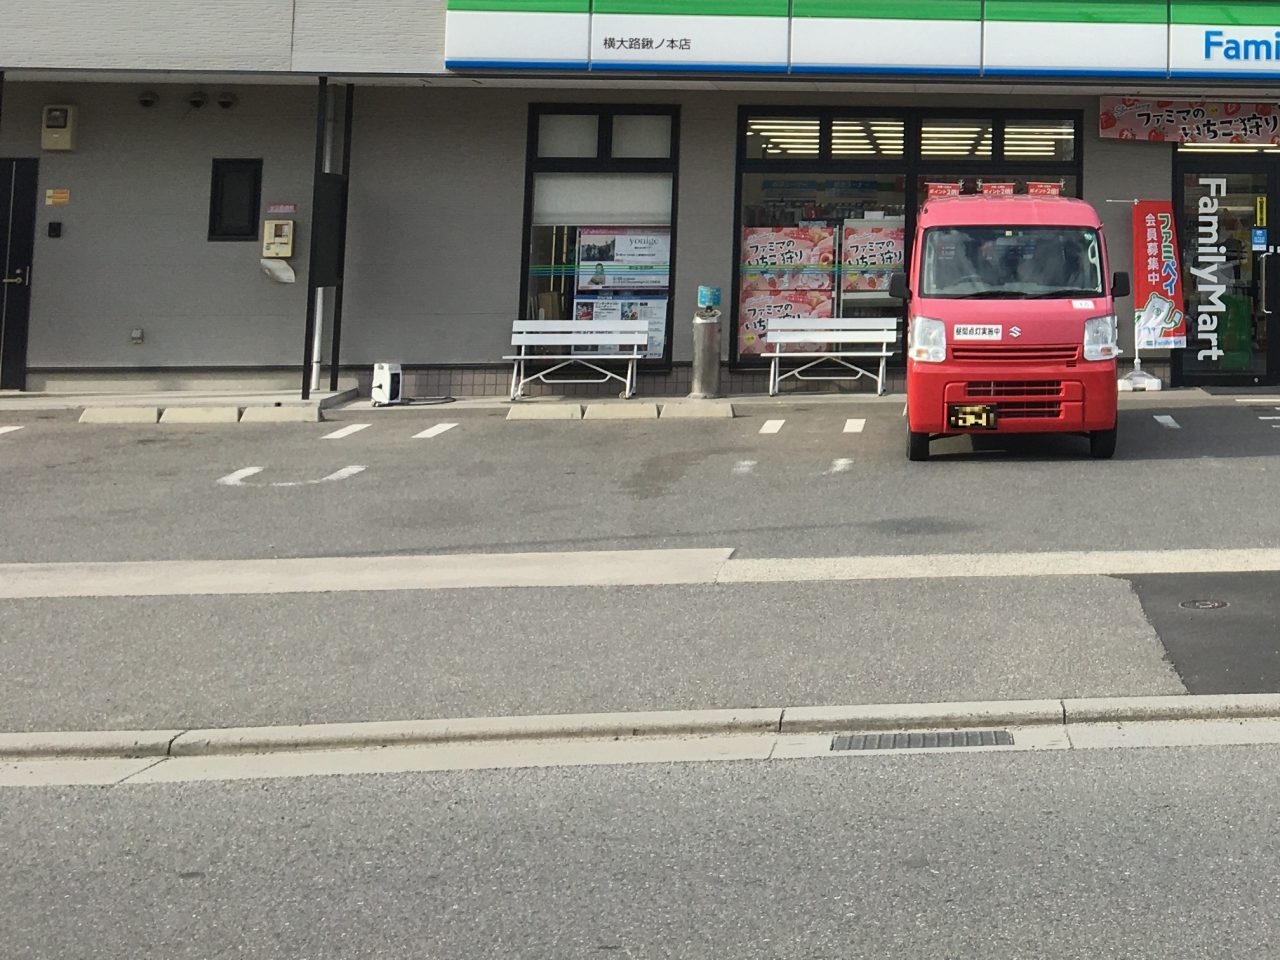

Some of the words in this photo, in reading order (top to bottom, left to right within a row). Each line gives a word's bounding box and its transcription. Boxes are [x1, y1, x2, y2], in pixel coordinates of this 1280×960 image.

[603, 37, 692, 50] 横大路鍬ノ本店
[1137, 108, 1205, 126] ファミマの
[1181, 114, 1278, 139] いちご狩り
[750, 240, 795, 254] ファミマの
[850, 240, 895, 254] ファミマの
[1145, 213, 1160, 285] 会員募集中
[1158, 214, 1178, 295] ファミペイ
[1190, 177, 1227, 361] FamilyMart
[748, 303, 793, 316] ファミマの
